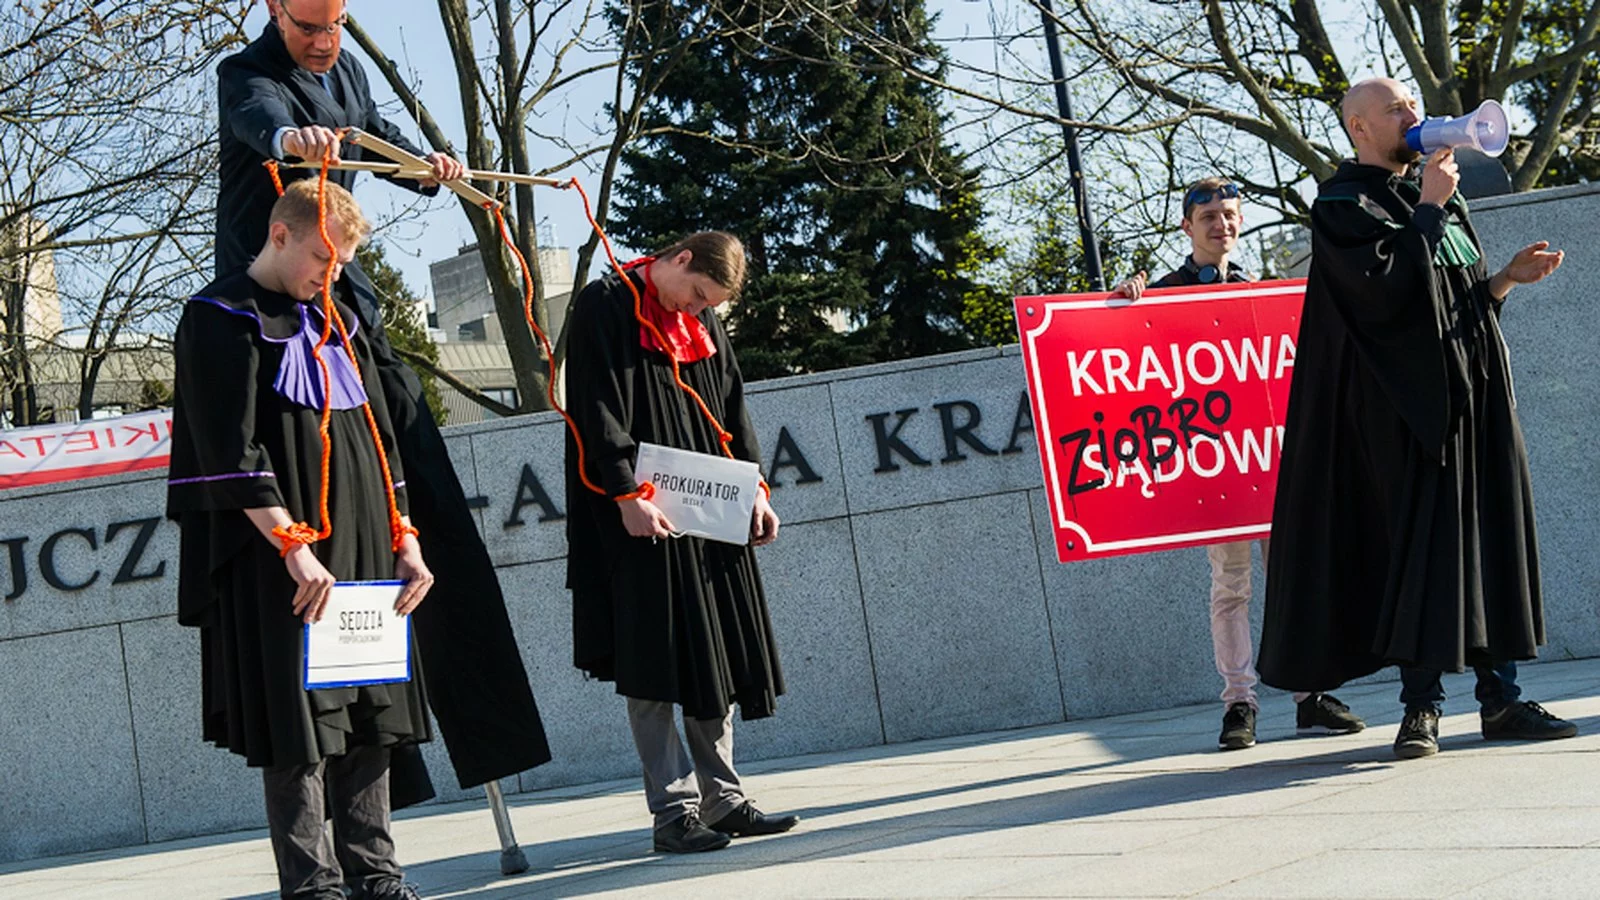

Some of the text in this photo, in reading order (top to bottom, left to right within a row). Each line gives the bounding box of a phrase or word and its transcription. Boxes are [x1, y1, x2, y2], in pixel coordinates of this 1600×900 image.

[1066, 334, 1298, 398] KRAJOWA
[652, 472, 740, 502] PROKURATOR
[1082, 425, 1285, 498] SĄDOW
[0, 517, 166, 600] JCZ
